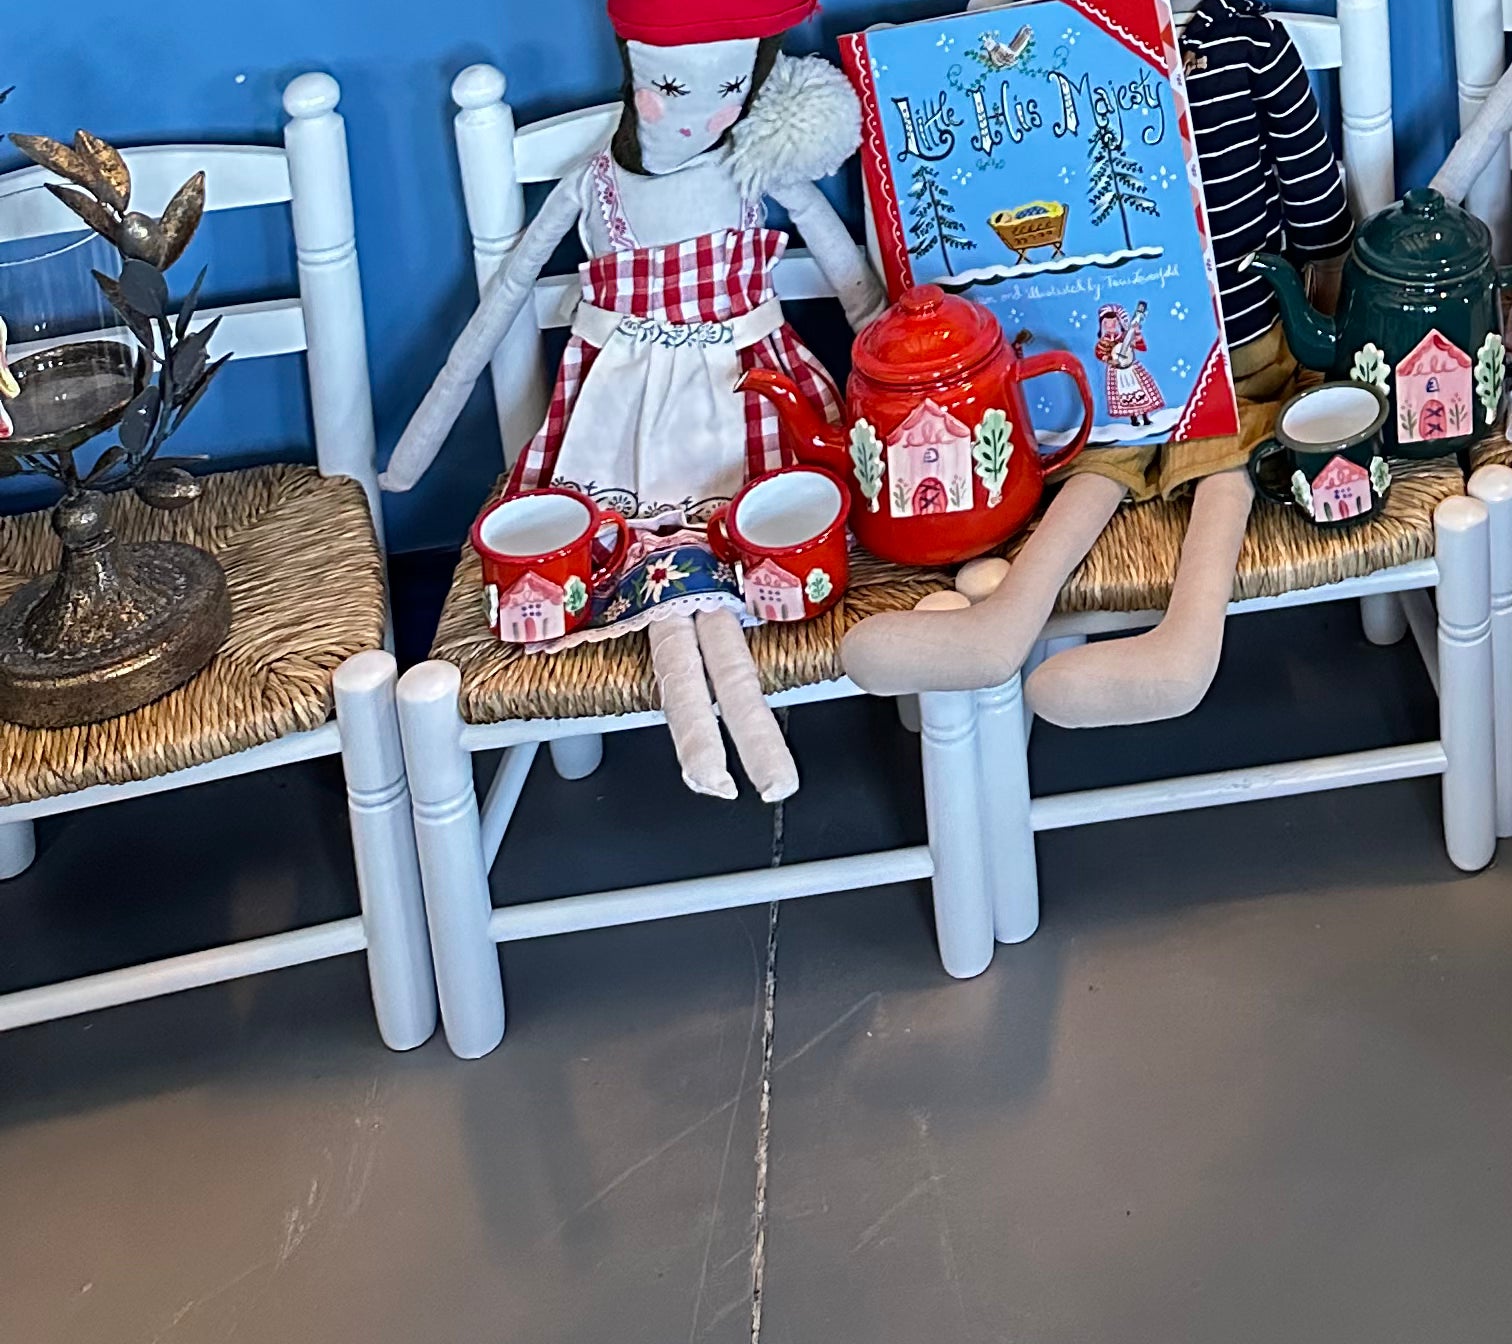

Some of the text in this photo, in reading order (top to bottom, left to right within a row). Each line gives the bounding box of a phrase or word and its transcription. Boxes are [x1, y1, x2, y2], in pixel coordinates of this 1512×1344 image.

[891, 67, 1165, 161] Little His Majesty
